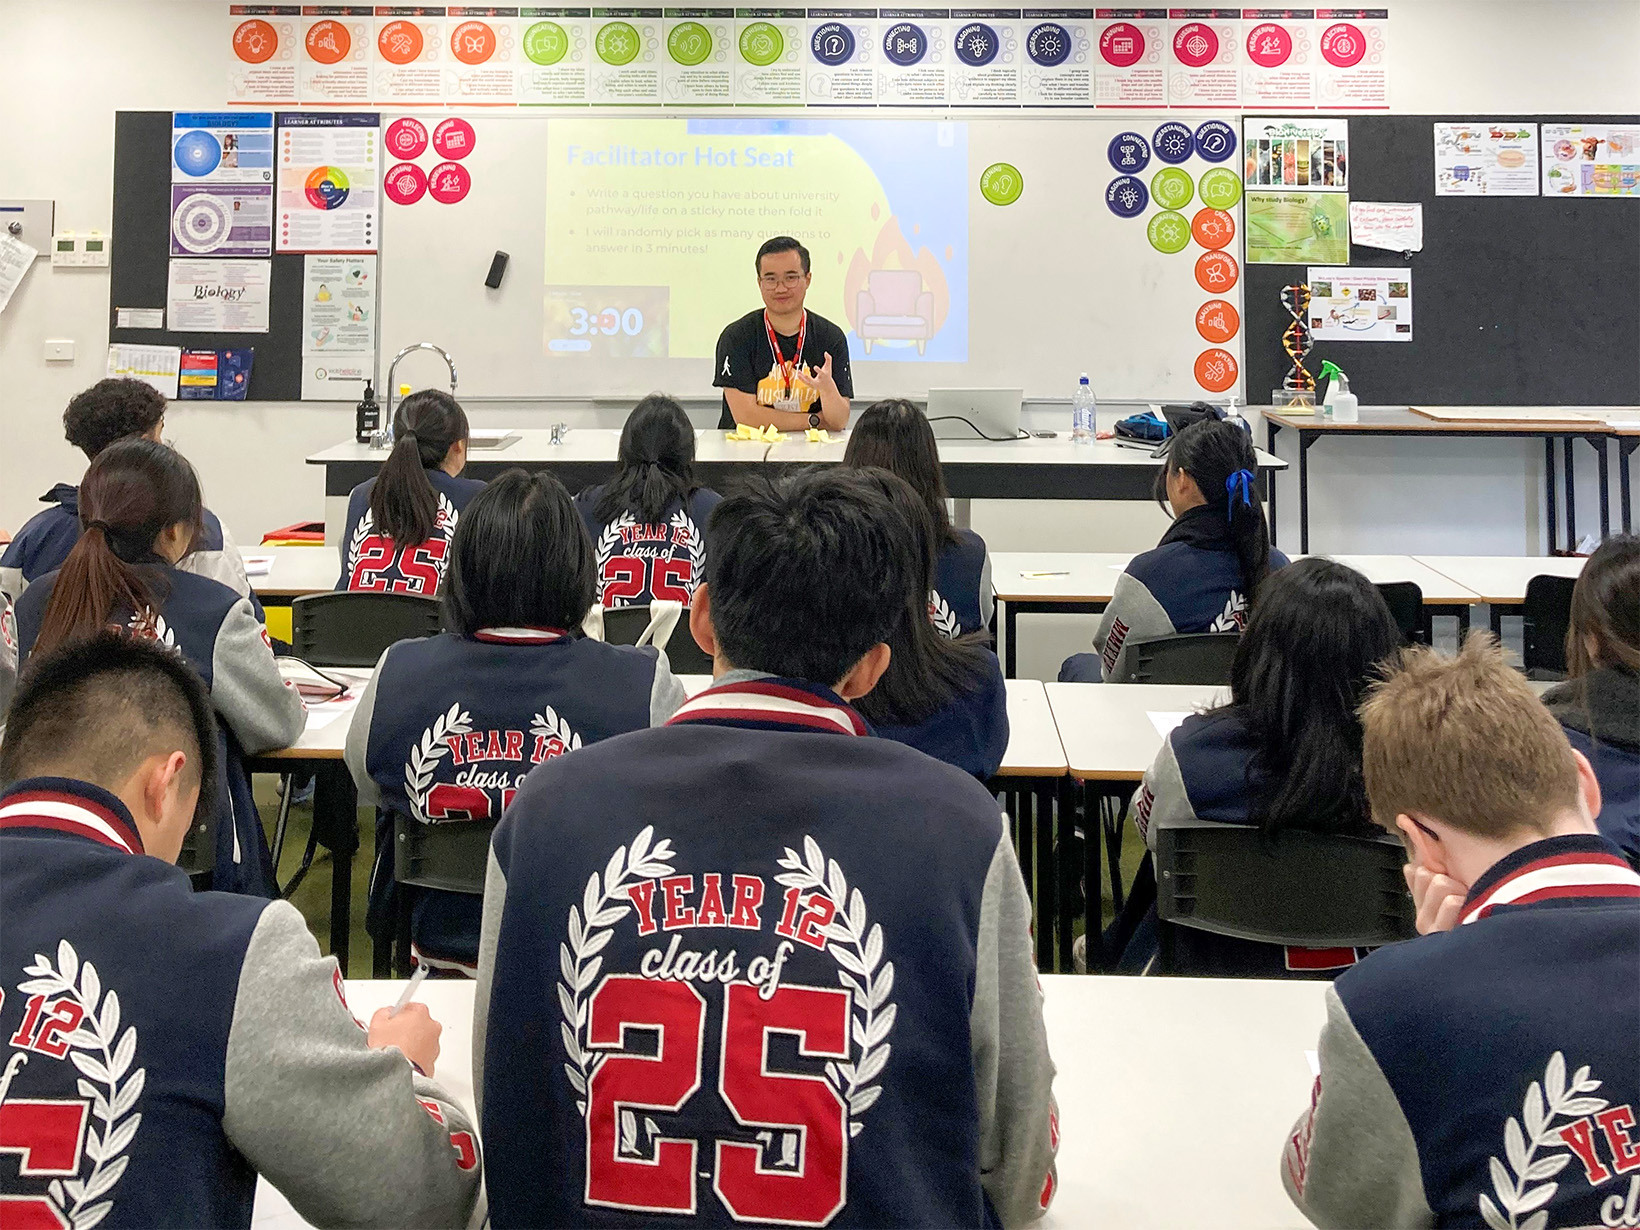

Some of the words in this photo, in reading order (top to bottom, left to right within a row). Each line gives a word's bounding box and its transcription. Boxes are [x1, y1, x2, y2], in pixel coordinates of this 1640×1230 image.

[237, 22, 257, 43] CREATING
[309, 22, 332, 46] ANALYSING
[382, 23, 402, 44] APPLYING
[454, 24, 484, 53] TRANSFORMING
[527, 24, 558, 54] COMMUNICATING
[598, 24, 628, 54] COLLABORATING
[671, 24, 693, 46] LISTENING
[814, 25, 841, 52] QUESTIONING
[886, 25, 911, 51] CONNECTING
[957, 25, 981, 49] REASONING
[1029, 25, 1061, 57] UNDERSTANDING
[1102, 25, 1125, 48] PLANNING
[1323, 26, 1347, 50] REFLECTING
[402, 120, 426, 143] REFLECTING
[1155, 124, 1191, 148] UNDERSTANDING
[1197, 122, 1230, 141] QUESTIONING
[567, 145, 689, 167] Facilitator
[695, 146, 737, 168] Hot
[744, 146, 795, 168] Seat
[1122, 134, 1148, 159] CONNECTING
[586, 188, 619, 199] Write
[622, 192, 629, 200] a
[632, 188, 685, 202] question
[687, 192, 710, 203] you
[713, 189, 740, 201] have
[744, 190, 781, 201] about
[783, 190, 840, 202] university
[1109, 178, 1131, 202] REASONING
[1201, 170, 1235, 199] COMMUNICATING
[586, 204, 657, 217] pathway/life
[662, 208, 677, 217] on
[681, 208, 688, 217] a
[690, 205, 725, 218] sticky
[729, 207, 755, 217] note
[758, 206, 786, 217] then
[789, 206, 812, 217] fold
[816, 207, 824, 217] it
[1251, 196, 1265, 206] Why
[1266, 197, 1282, 206] study
[1283, 197, 1308, 206] Biology?
[1214, 210, 1234, 233] CREATING
[586, 228, 590, 238] I
[593, 227, 613, 238] will
[616, 227, 673, 240] randomly
[676, 227, 701, 240] pick
[704, 230, 718, 239] as
[721, 230, 754, 242] many
[757, 229, 816, 241] questions
[819, 230, 831, 240] to
[329, 257, 345, 265] Safety
[586, 245, 628, 254] answer
[632, 243, 642, 254] in
[646, 243, 653, 254] 3
[656, 244, 709, 255] minutes!
[1202, 252, 1236, 278] TRANSFORMING
[193, 285, 246, 301] Biology
[569, 307, 644, 336] 3:00
[1199, 302, 1222, 325] ANALYSING
[1214, 351, 1235, 372] APPLYING
[757, 387, 820, 405] AUSTALIA
[619, 522, 668, 546] YEAR
[670, 526, 692, 549] 12
[348, 534, 451, 596] 25
[623, 543, 659, 559] class
[660, 544, 678, 564] of
[447, 729, 524, 766] YEAR
[529, 734, 566, 765] 12
[456, 763, 511, 790] class
[627, 873, 765, 937] YEAR
[774, 887, 839, 952] 12
[640, 935, 740, 985] class
[747, 941, 794, 1001] of
[8, 993, 88, 1061] 12
[584, 972, 853, 1228] 25
